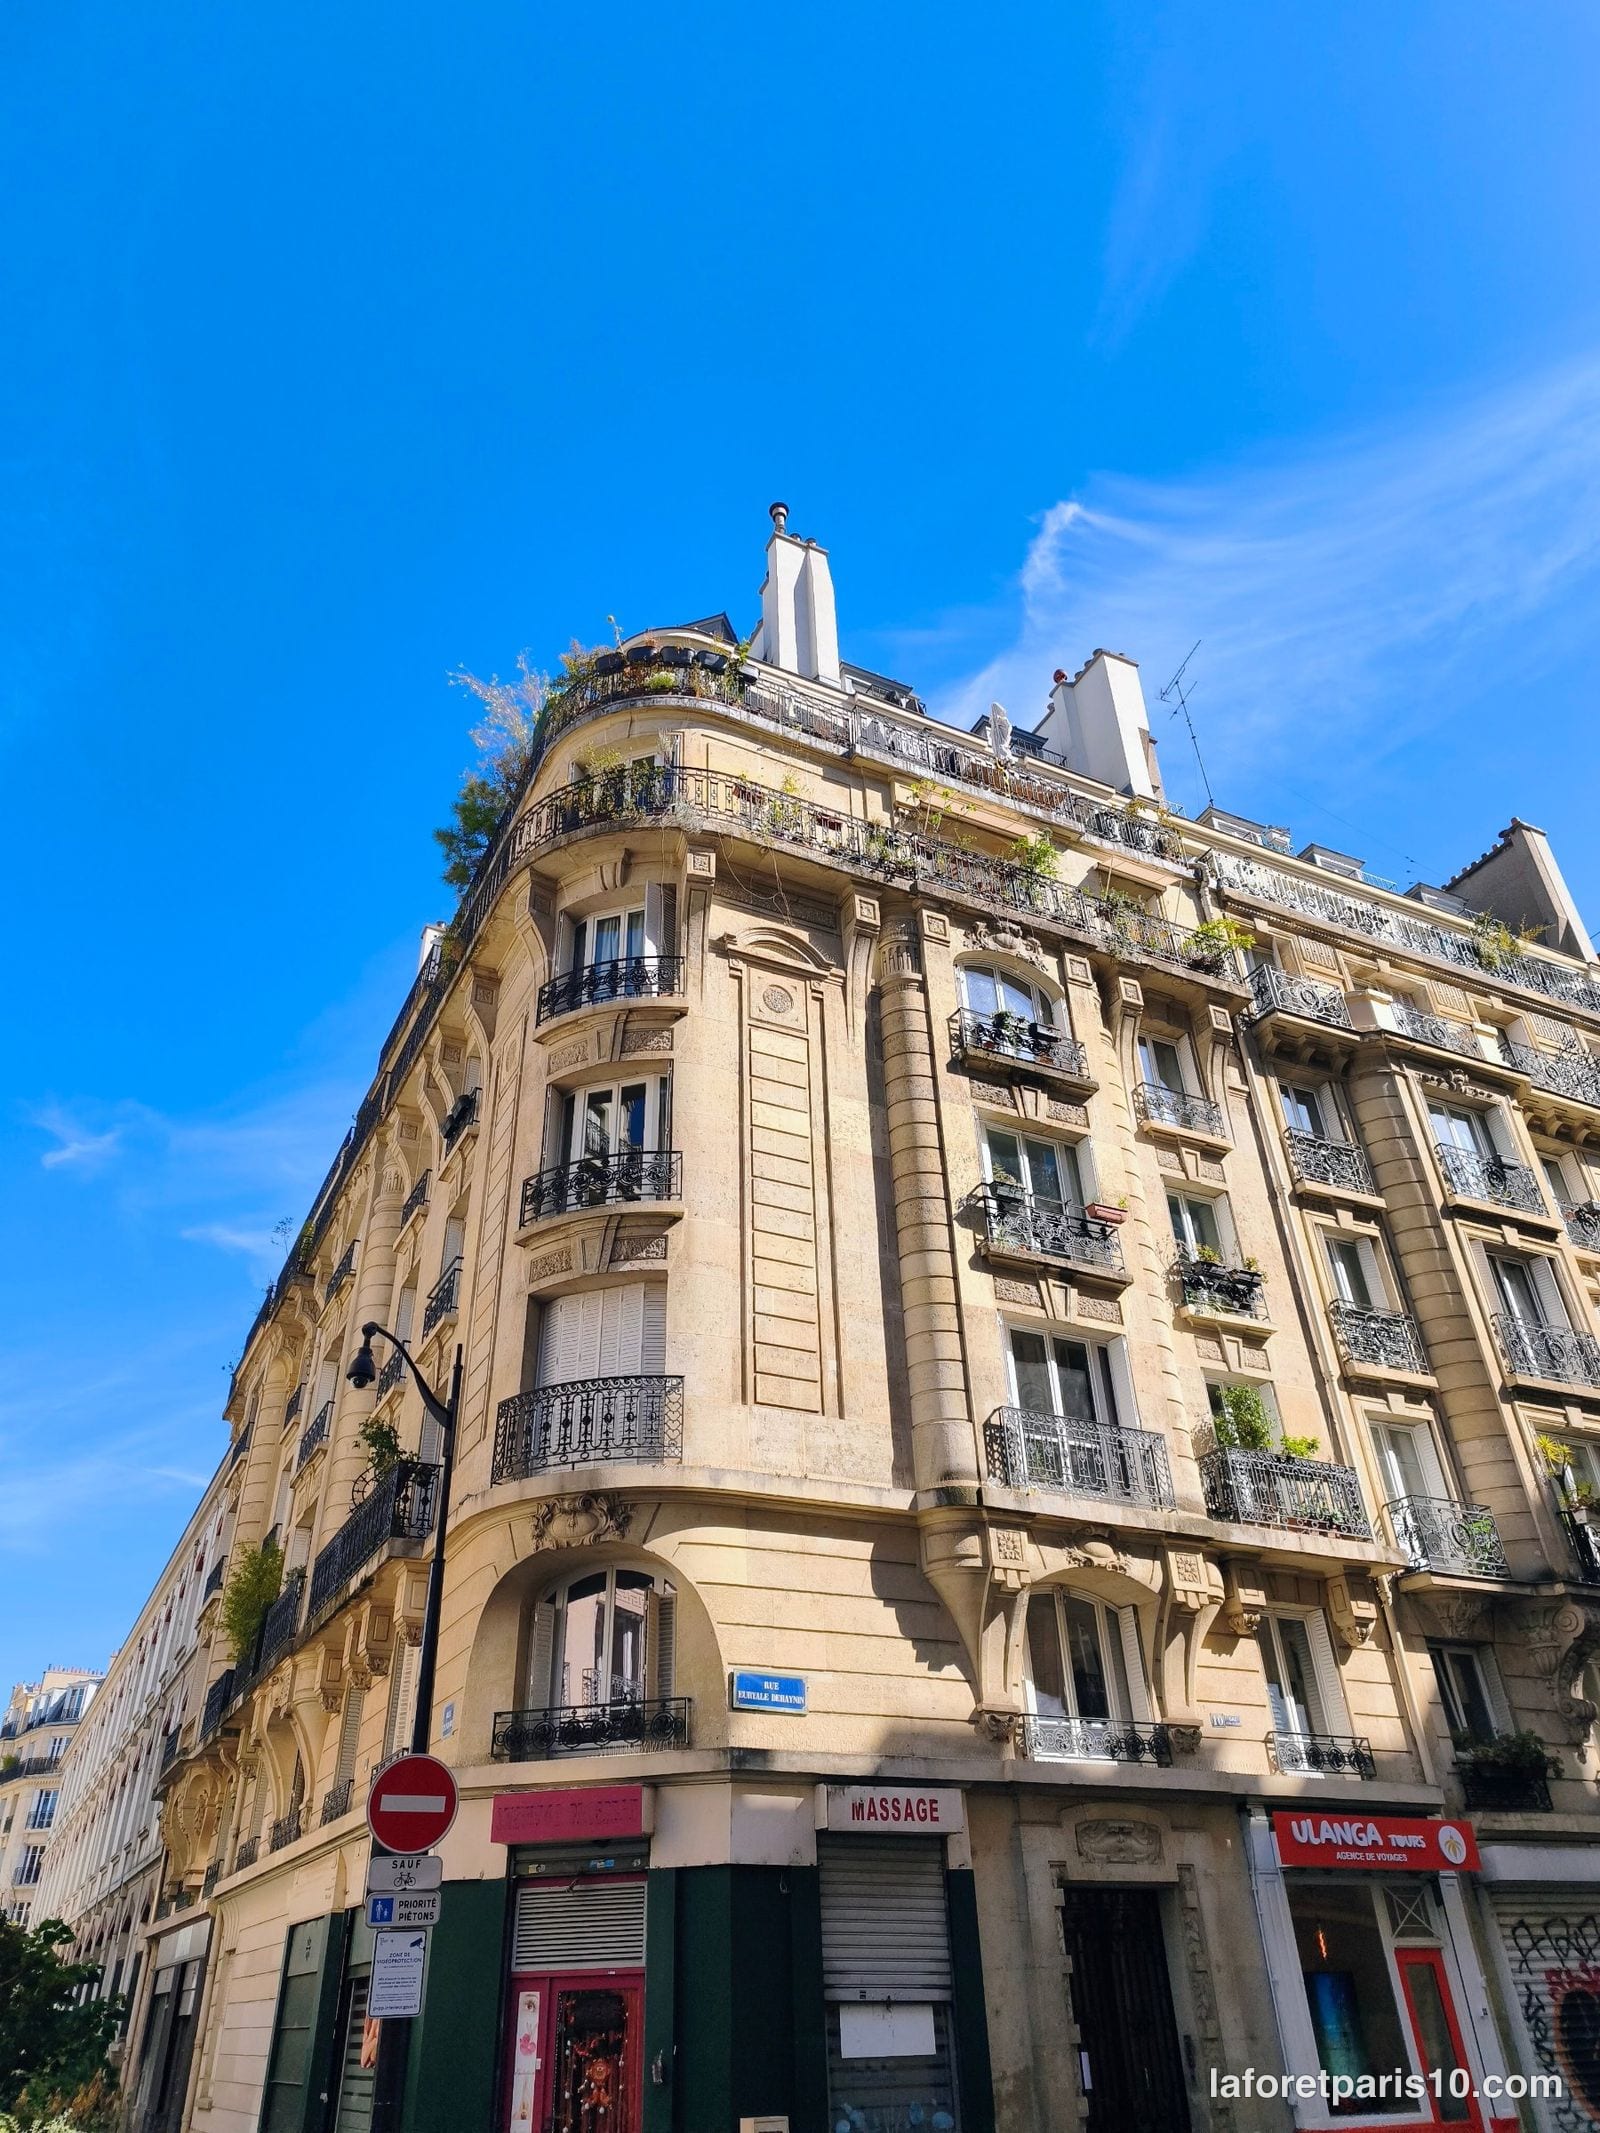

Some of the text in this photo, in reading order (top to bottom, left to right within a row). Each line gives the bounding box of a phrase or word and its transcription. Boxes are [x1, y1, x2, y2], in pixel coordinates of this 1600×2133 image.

[764, 1681, 780, 1690] RUE
[738, 1690, 770, 1701] EURYALE
[852, 1797, 940, 1822] MASSAGE
[1291, 1818, 1426, 1848] ULANGA TOURS
[1336, 1851, 1408, 1862] AGENCE DE VOYAGES
[391, 1860, 422, 1869] SAUF
[398, 1898, 437, 1909] PRIORITÉ
